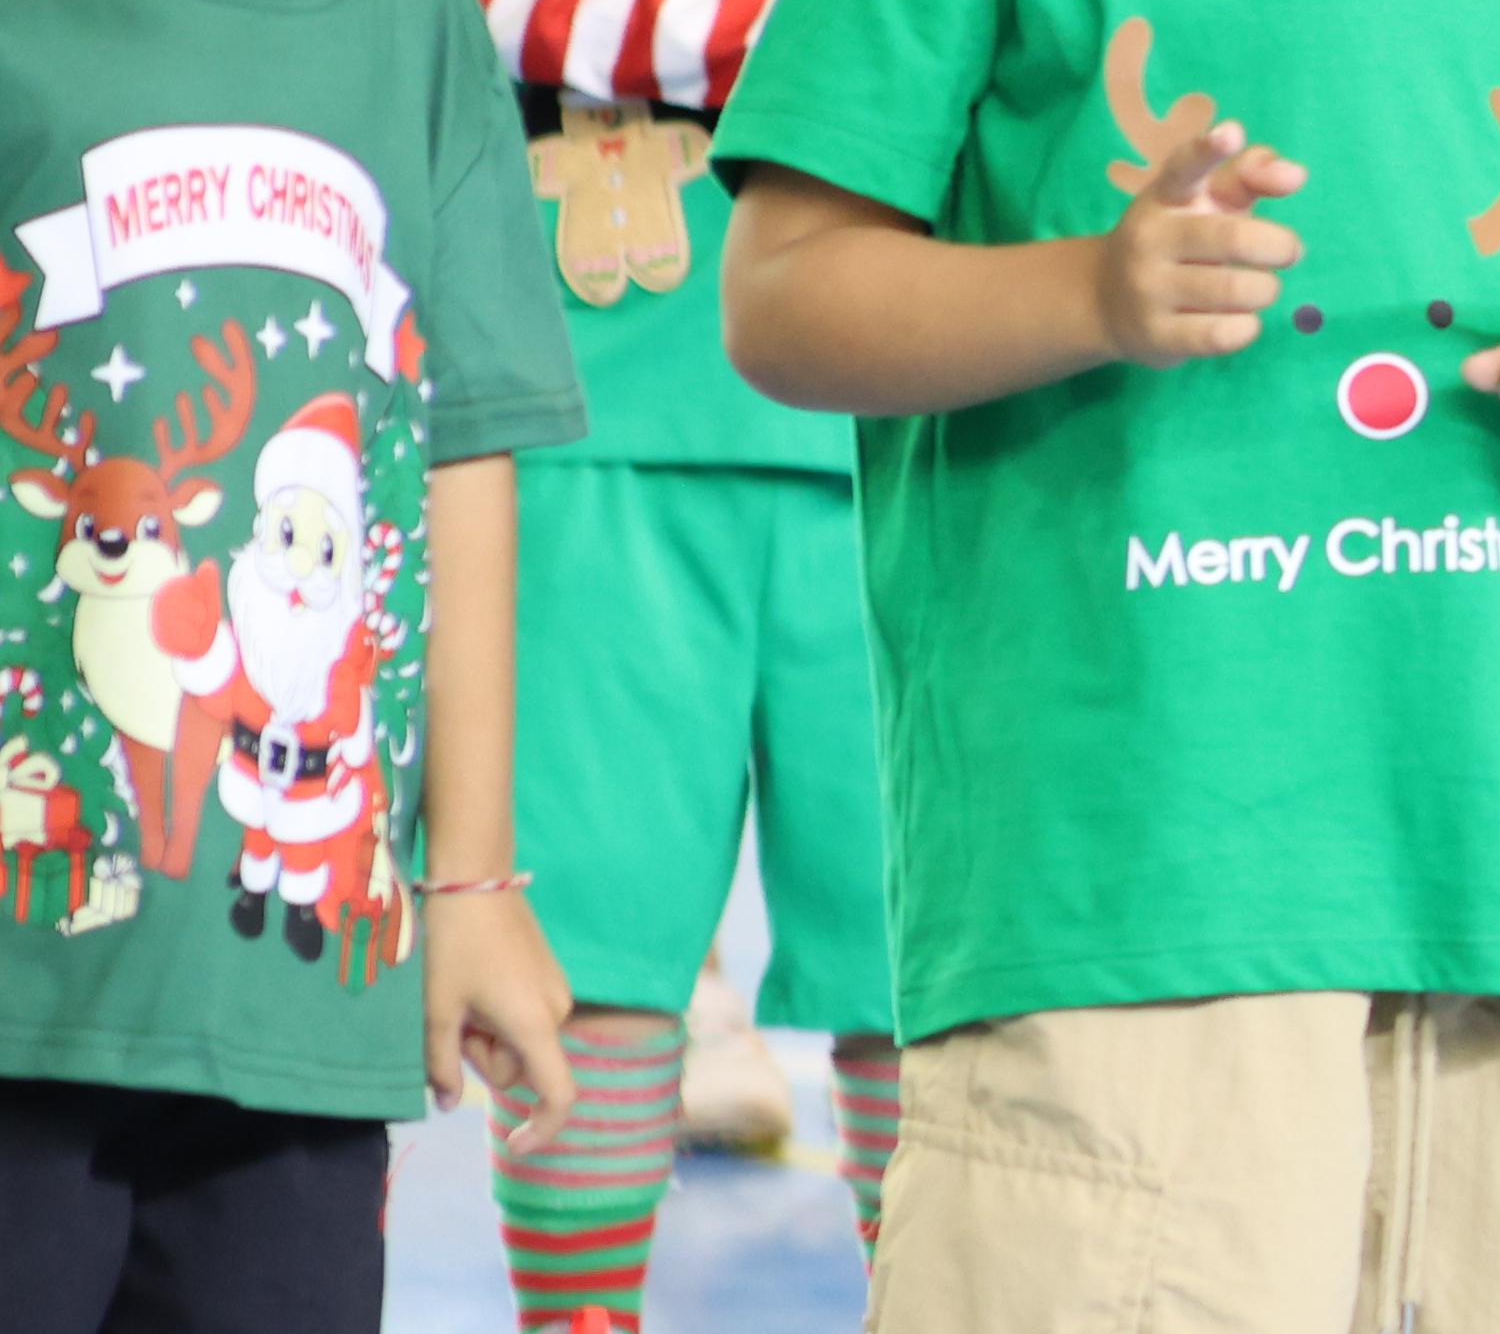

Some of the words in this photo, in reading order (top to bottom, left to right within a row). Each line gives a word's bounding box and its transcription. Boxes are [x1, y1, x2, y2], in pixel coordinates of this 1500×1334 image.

[105, 163, 231, 250] MERRY
[247, 163, 375, 294] CHRISTMAS
[1125, 532, 1311, 593] Merry
